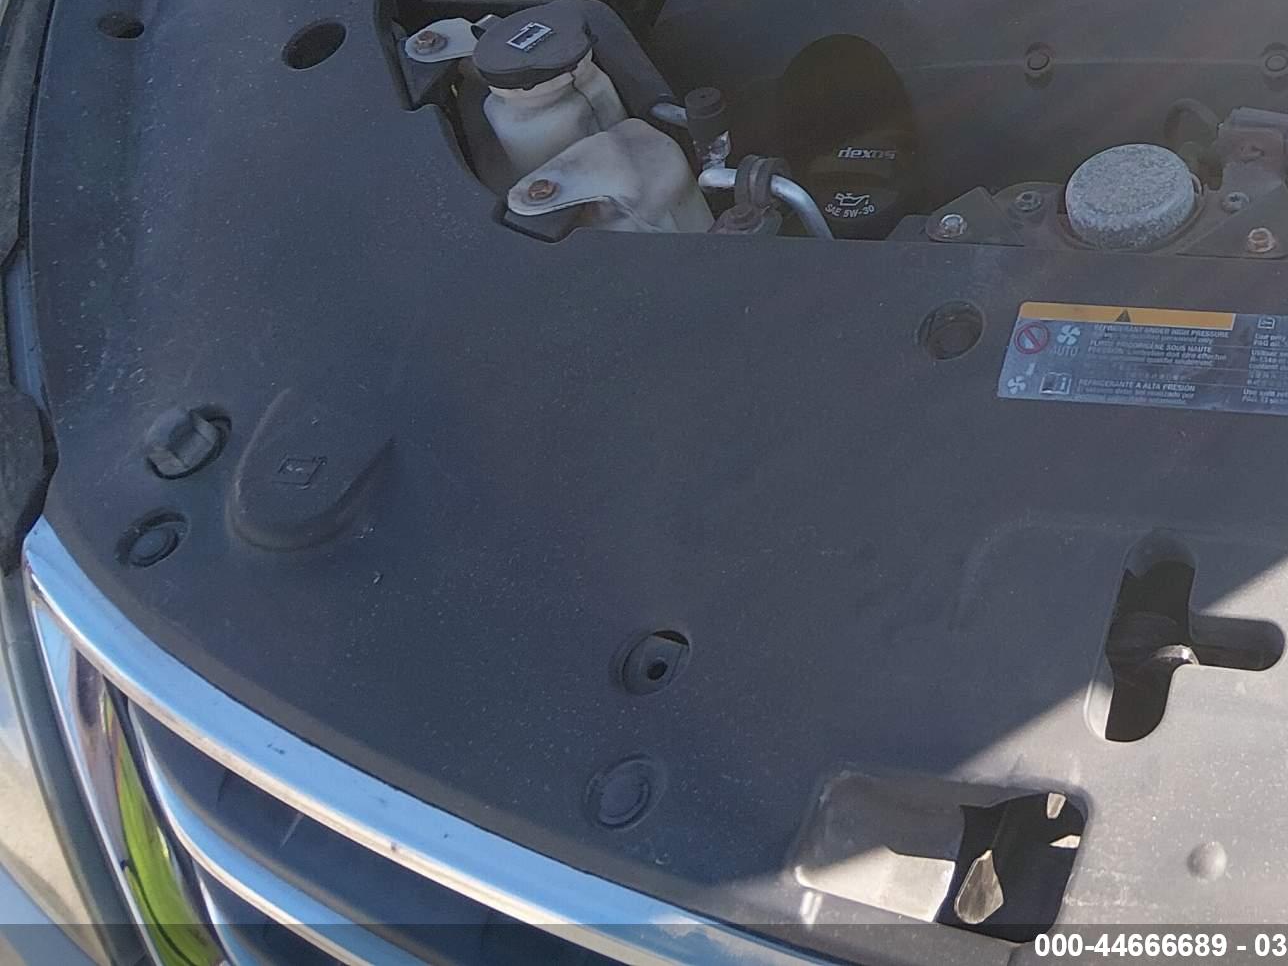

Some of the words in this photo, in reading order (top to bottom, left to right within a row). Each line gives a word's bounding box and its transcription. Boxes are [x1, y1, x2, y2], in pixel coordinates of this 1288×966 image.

[837, 146, 897, 160] dexos
[824, 203, 842, 217] SAE
[843, 205, 875, 218] 5W-30
